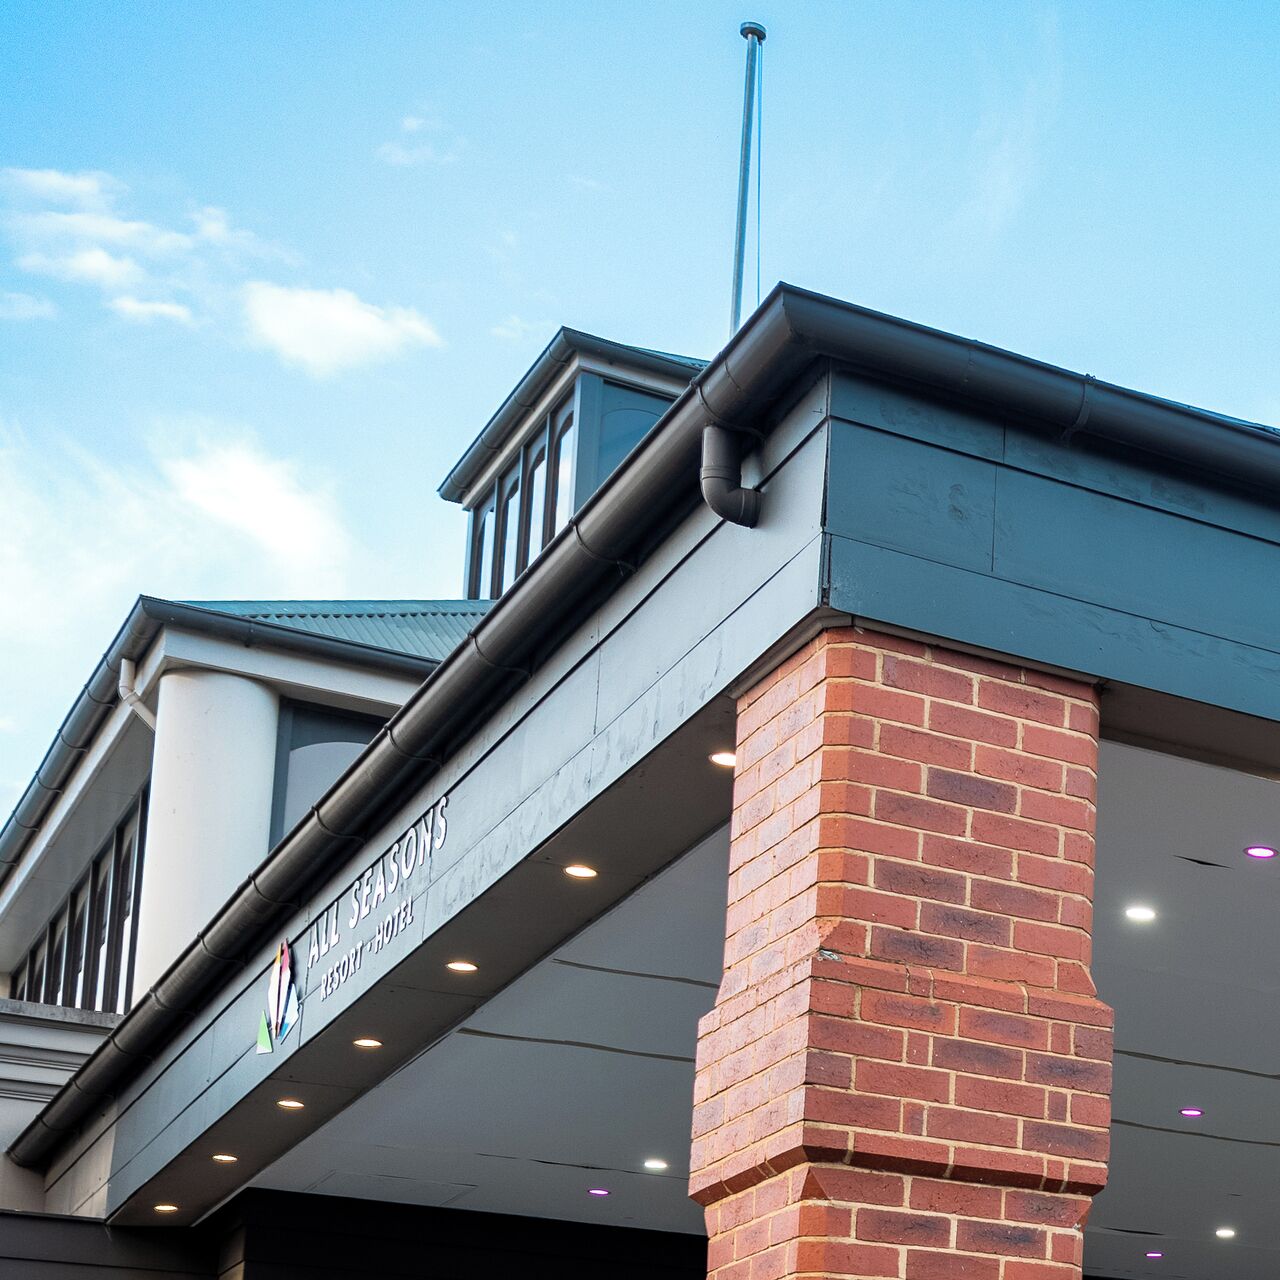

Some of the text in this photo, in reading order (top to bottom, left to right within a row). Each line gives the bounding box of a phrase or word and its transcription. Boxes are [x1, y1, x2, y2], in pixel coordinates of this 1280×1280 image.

[307, 796, 449, 969] ALL SEASONS
[320, 896, 414, 1002] RESORT HOTEL
